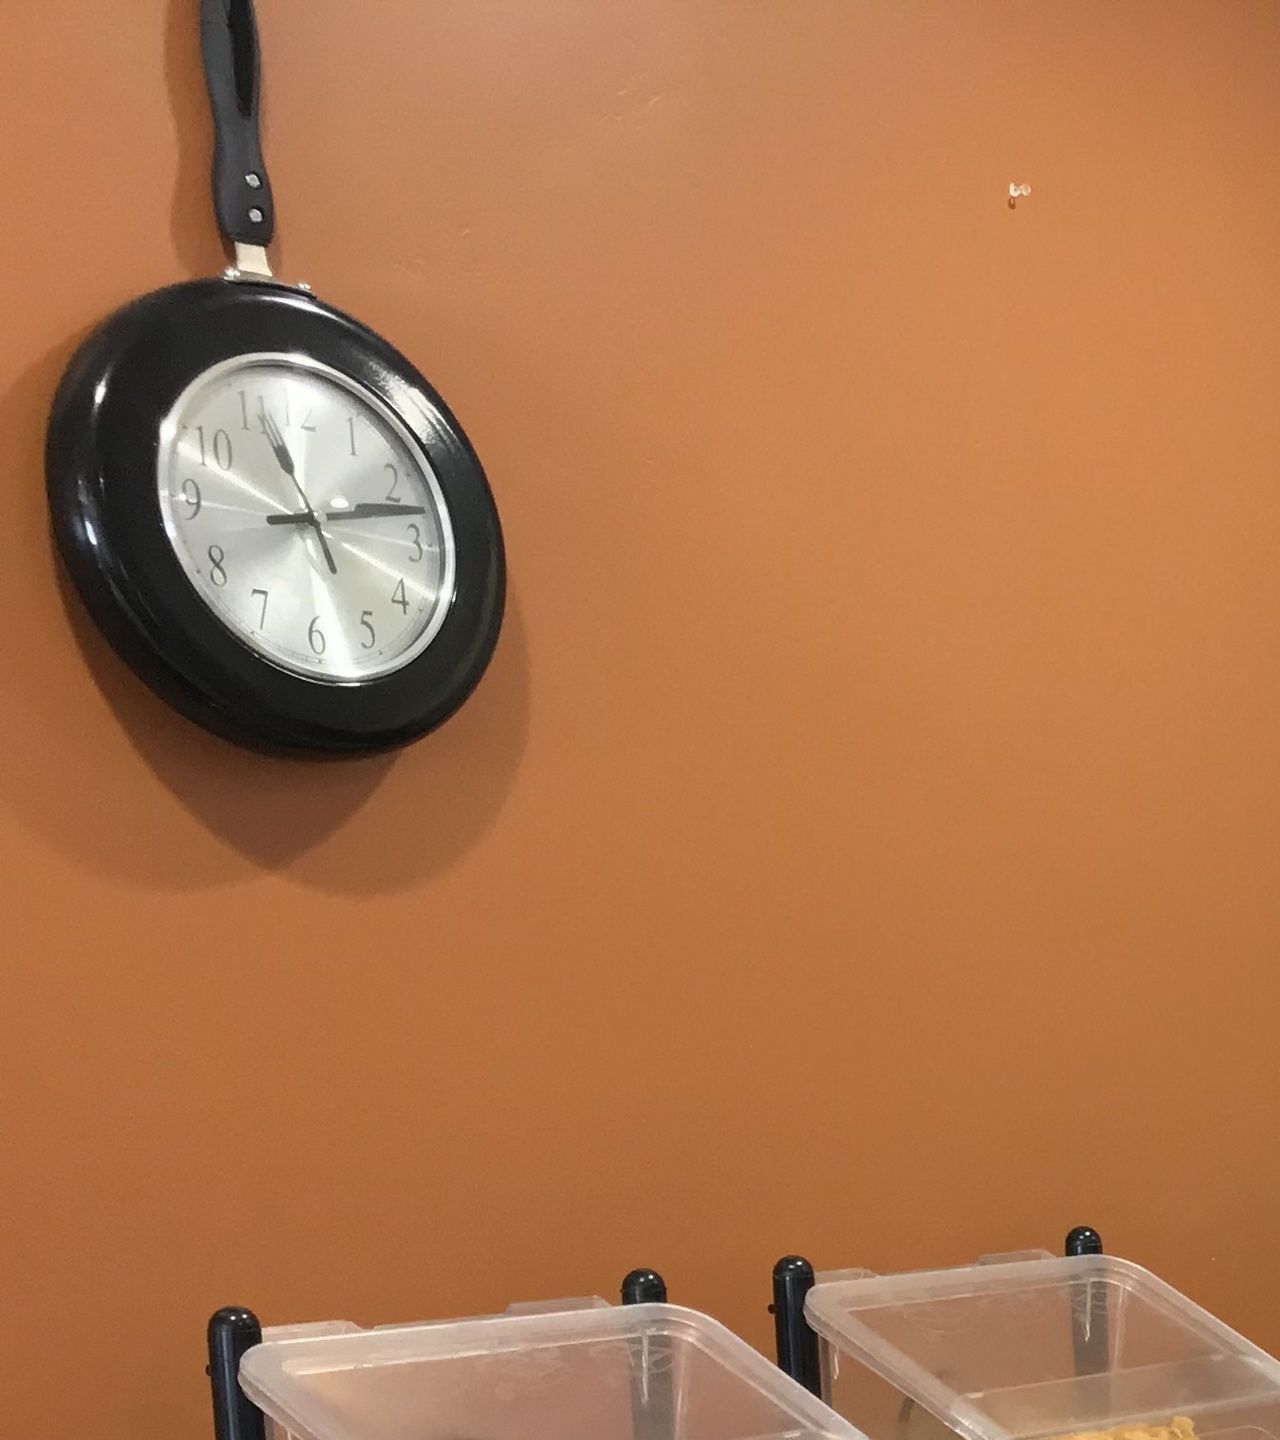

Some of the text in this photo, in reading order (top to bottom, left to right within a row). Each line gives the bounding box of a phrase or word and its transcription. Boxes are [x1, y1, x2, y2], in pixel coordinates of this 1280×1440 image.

[195, 425, 234, 472] 10
[346, 415, 358, 457] 1
[181, 478, 202, 521] 9
[384, 463, 402, 504] 2
[407, 523, 424, 563] 3
[207, 544, 228, 587] 8
[251, 588, 269, 631] 7
[391, 577, 411, 616] 4
[307, 615, 327, 656] 6
[360, 610, 376, 650] 5
